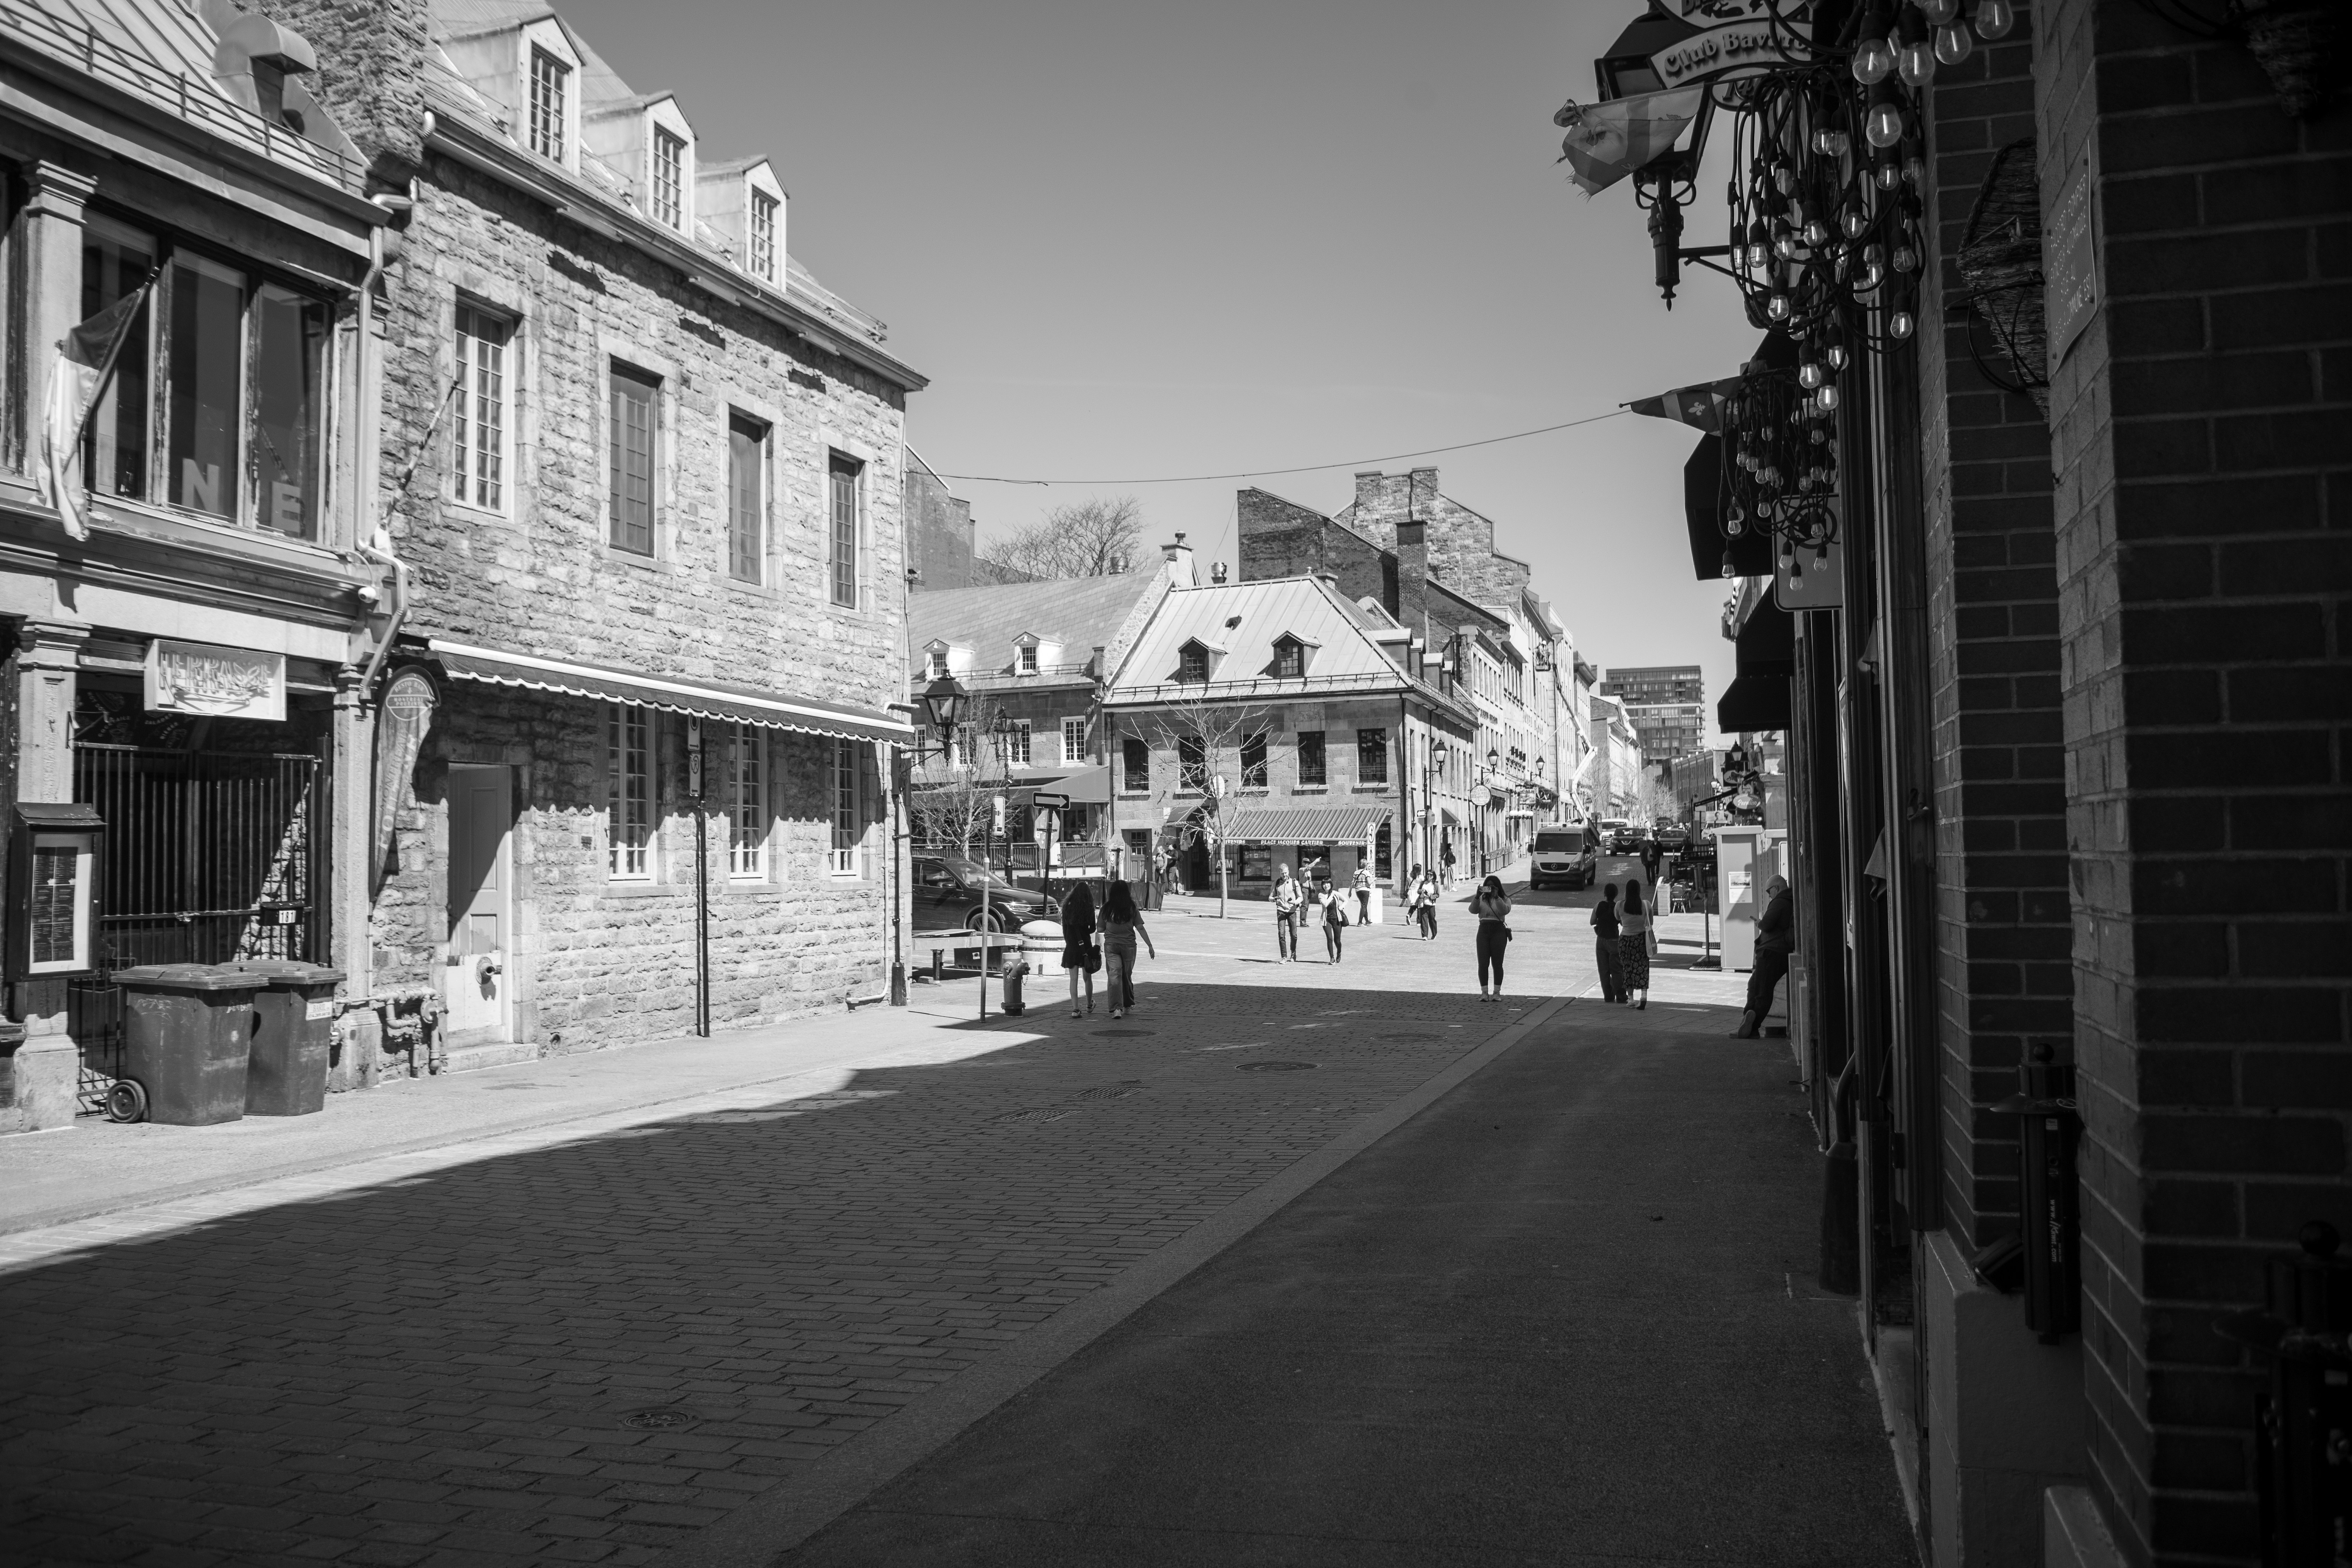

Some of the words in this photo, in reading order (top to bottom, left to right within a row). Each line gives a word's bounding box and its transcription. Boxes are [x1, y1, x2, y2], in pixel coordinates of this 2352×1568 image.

[1665, 39, 1717, 74] Club
[1723, 31, 1812, 52] Bavro
[2068, 173, 2086, 222] POMPIER
[2067, 285, 2082, 325] COMMUNE
[1216, 860, 1232, 868] AM
